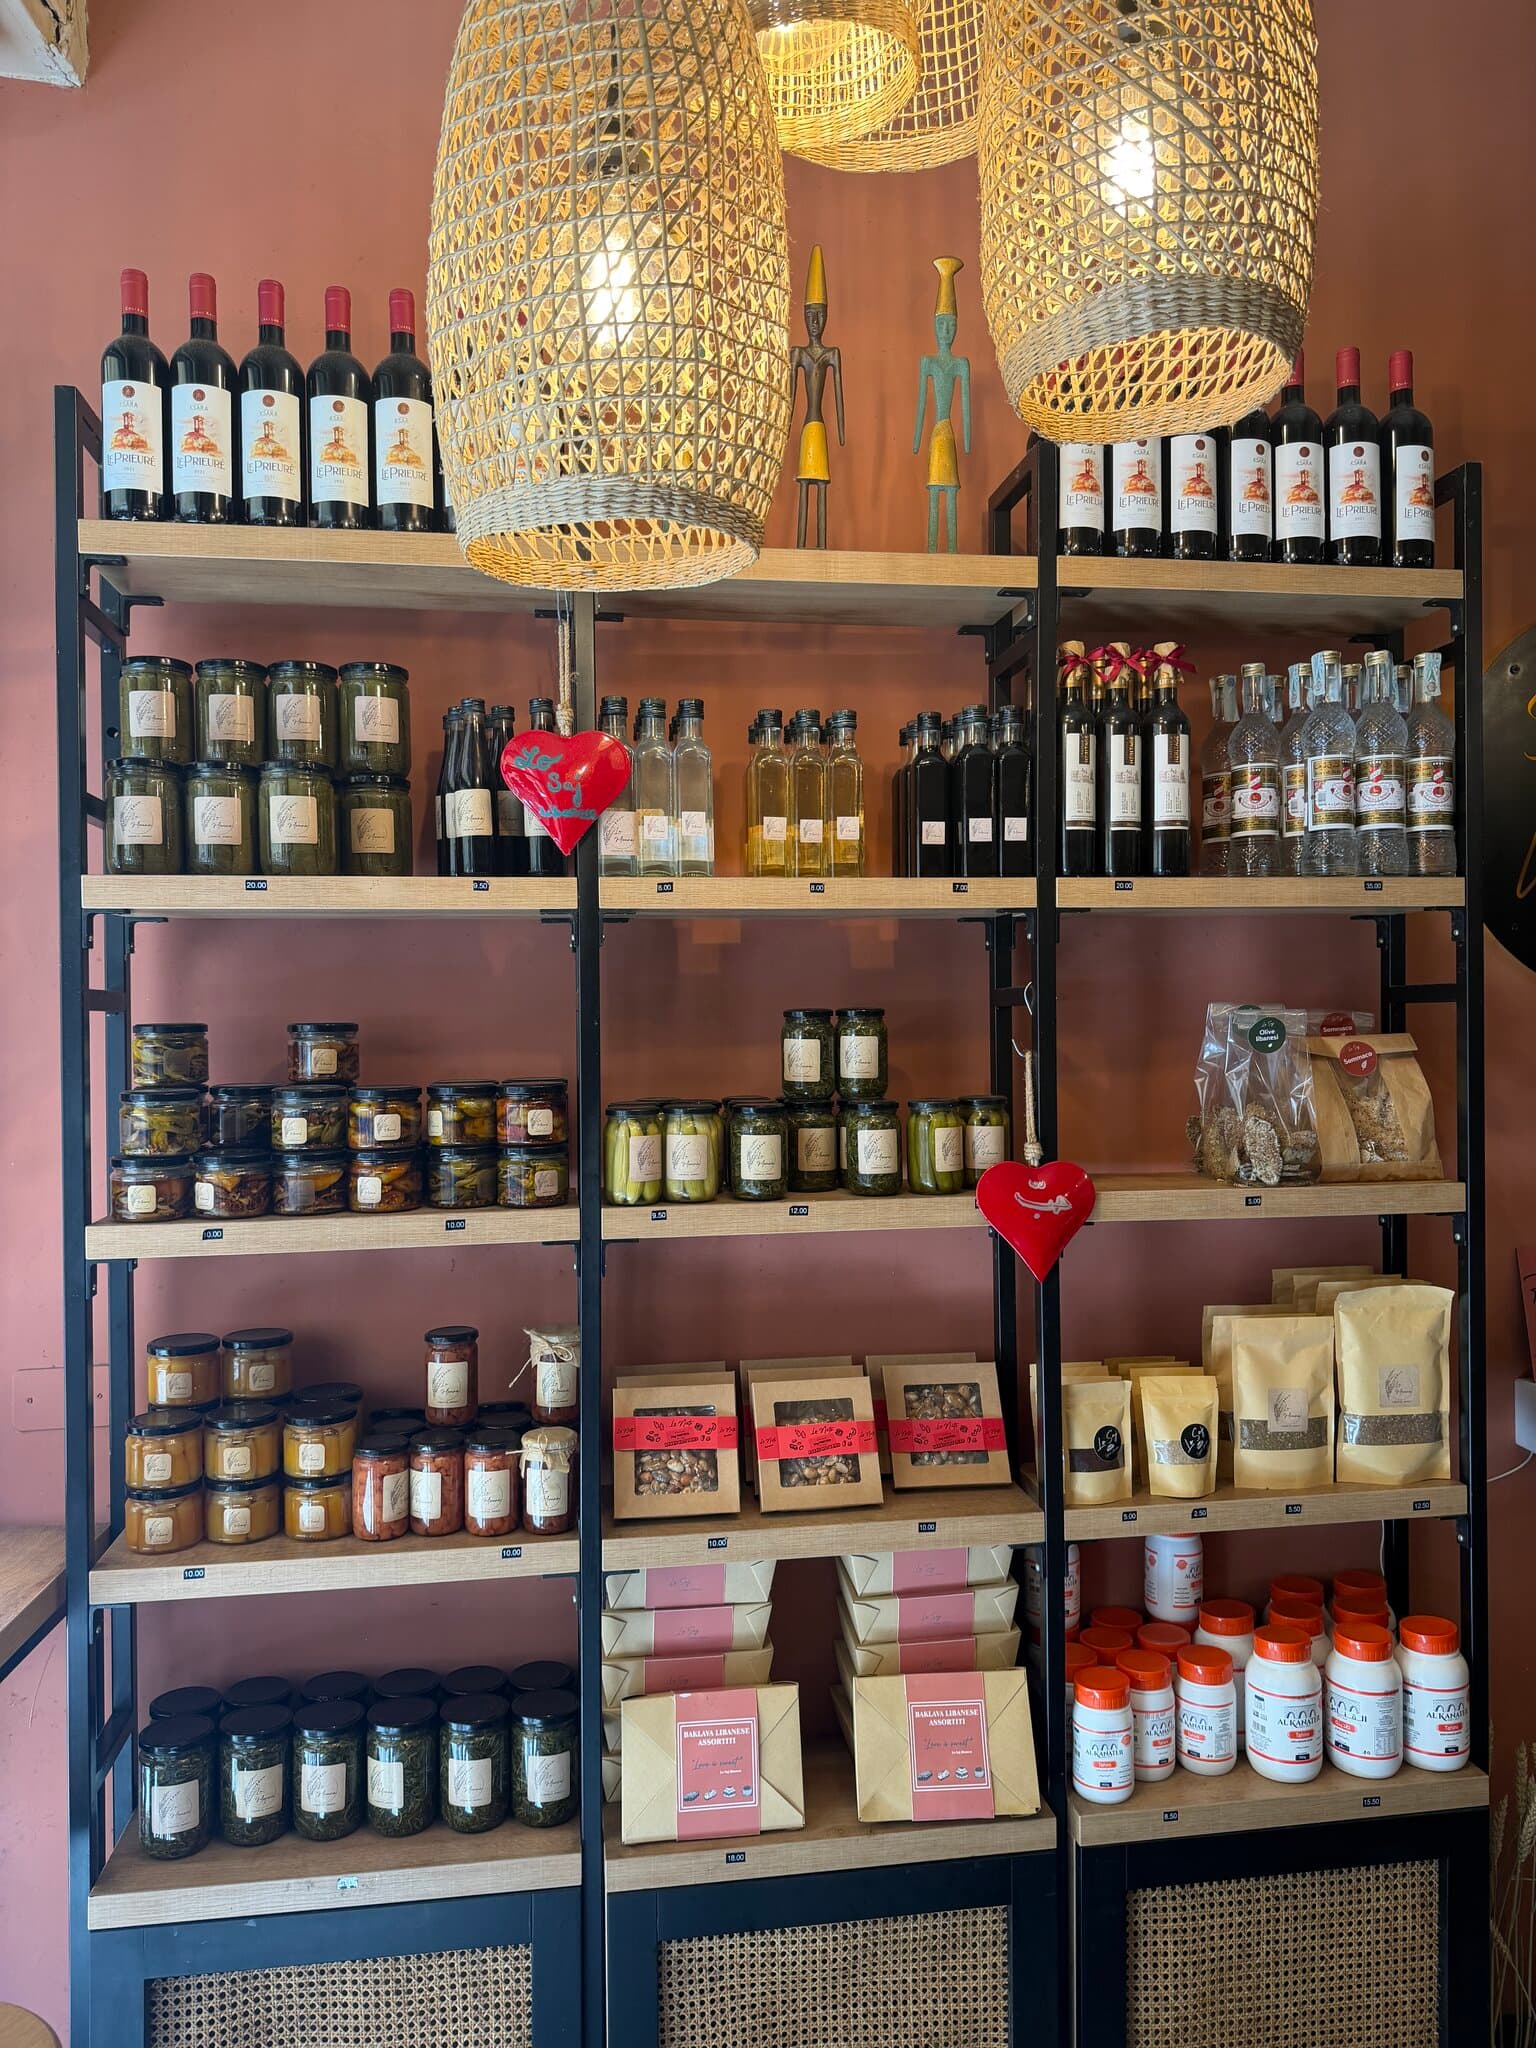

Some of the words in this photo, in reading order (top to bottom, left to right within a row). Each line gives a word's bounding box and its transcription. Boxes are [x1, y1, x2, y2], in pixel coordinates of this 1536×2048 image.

[246, 881, 267, 889] 20.00
[1343, 1051, 1373, 1065] Sommaco
[791, 1206, 807, 1214] 12.00
[447, 1220, 465, 1229] 10.00
[709, 1538, 727, 1548] 10.00
[502, 1548, 521, 1557] 10.00
[184, 1569, 205, 1578] 10.00
[945, 1709, 979, 1717] LIBANESE
[929, 1718, 965, 1726] ASSORTITI
[683, 1730, 714, 1738] BAKLAVA
[715, 1727, 750, 1737] LIBANESE
[698, 1737, 736, 1746] ASSORTITI
[727, 1853, 745, 1862] 18.00
